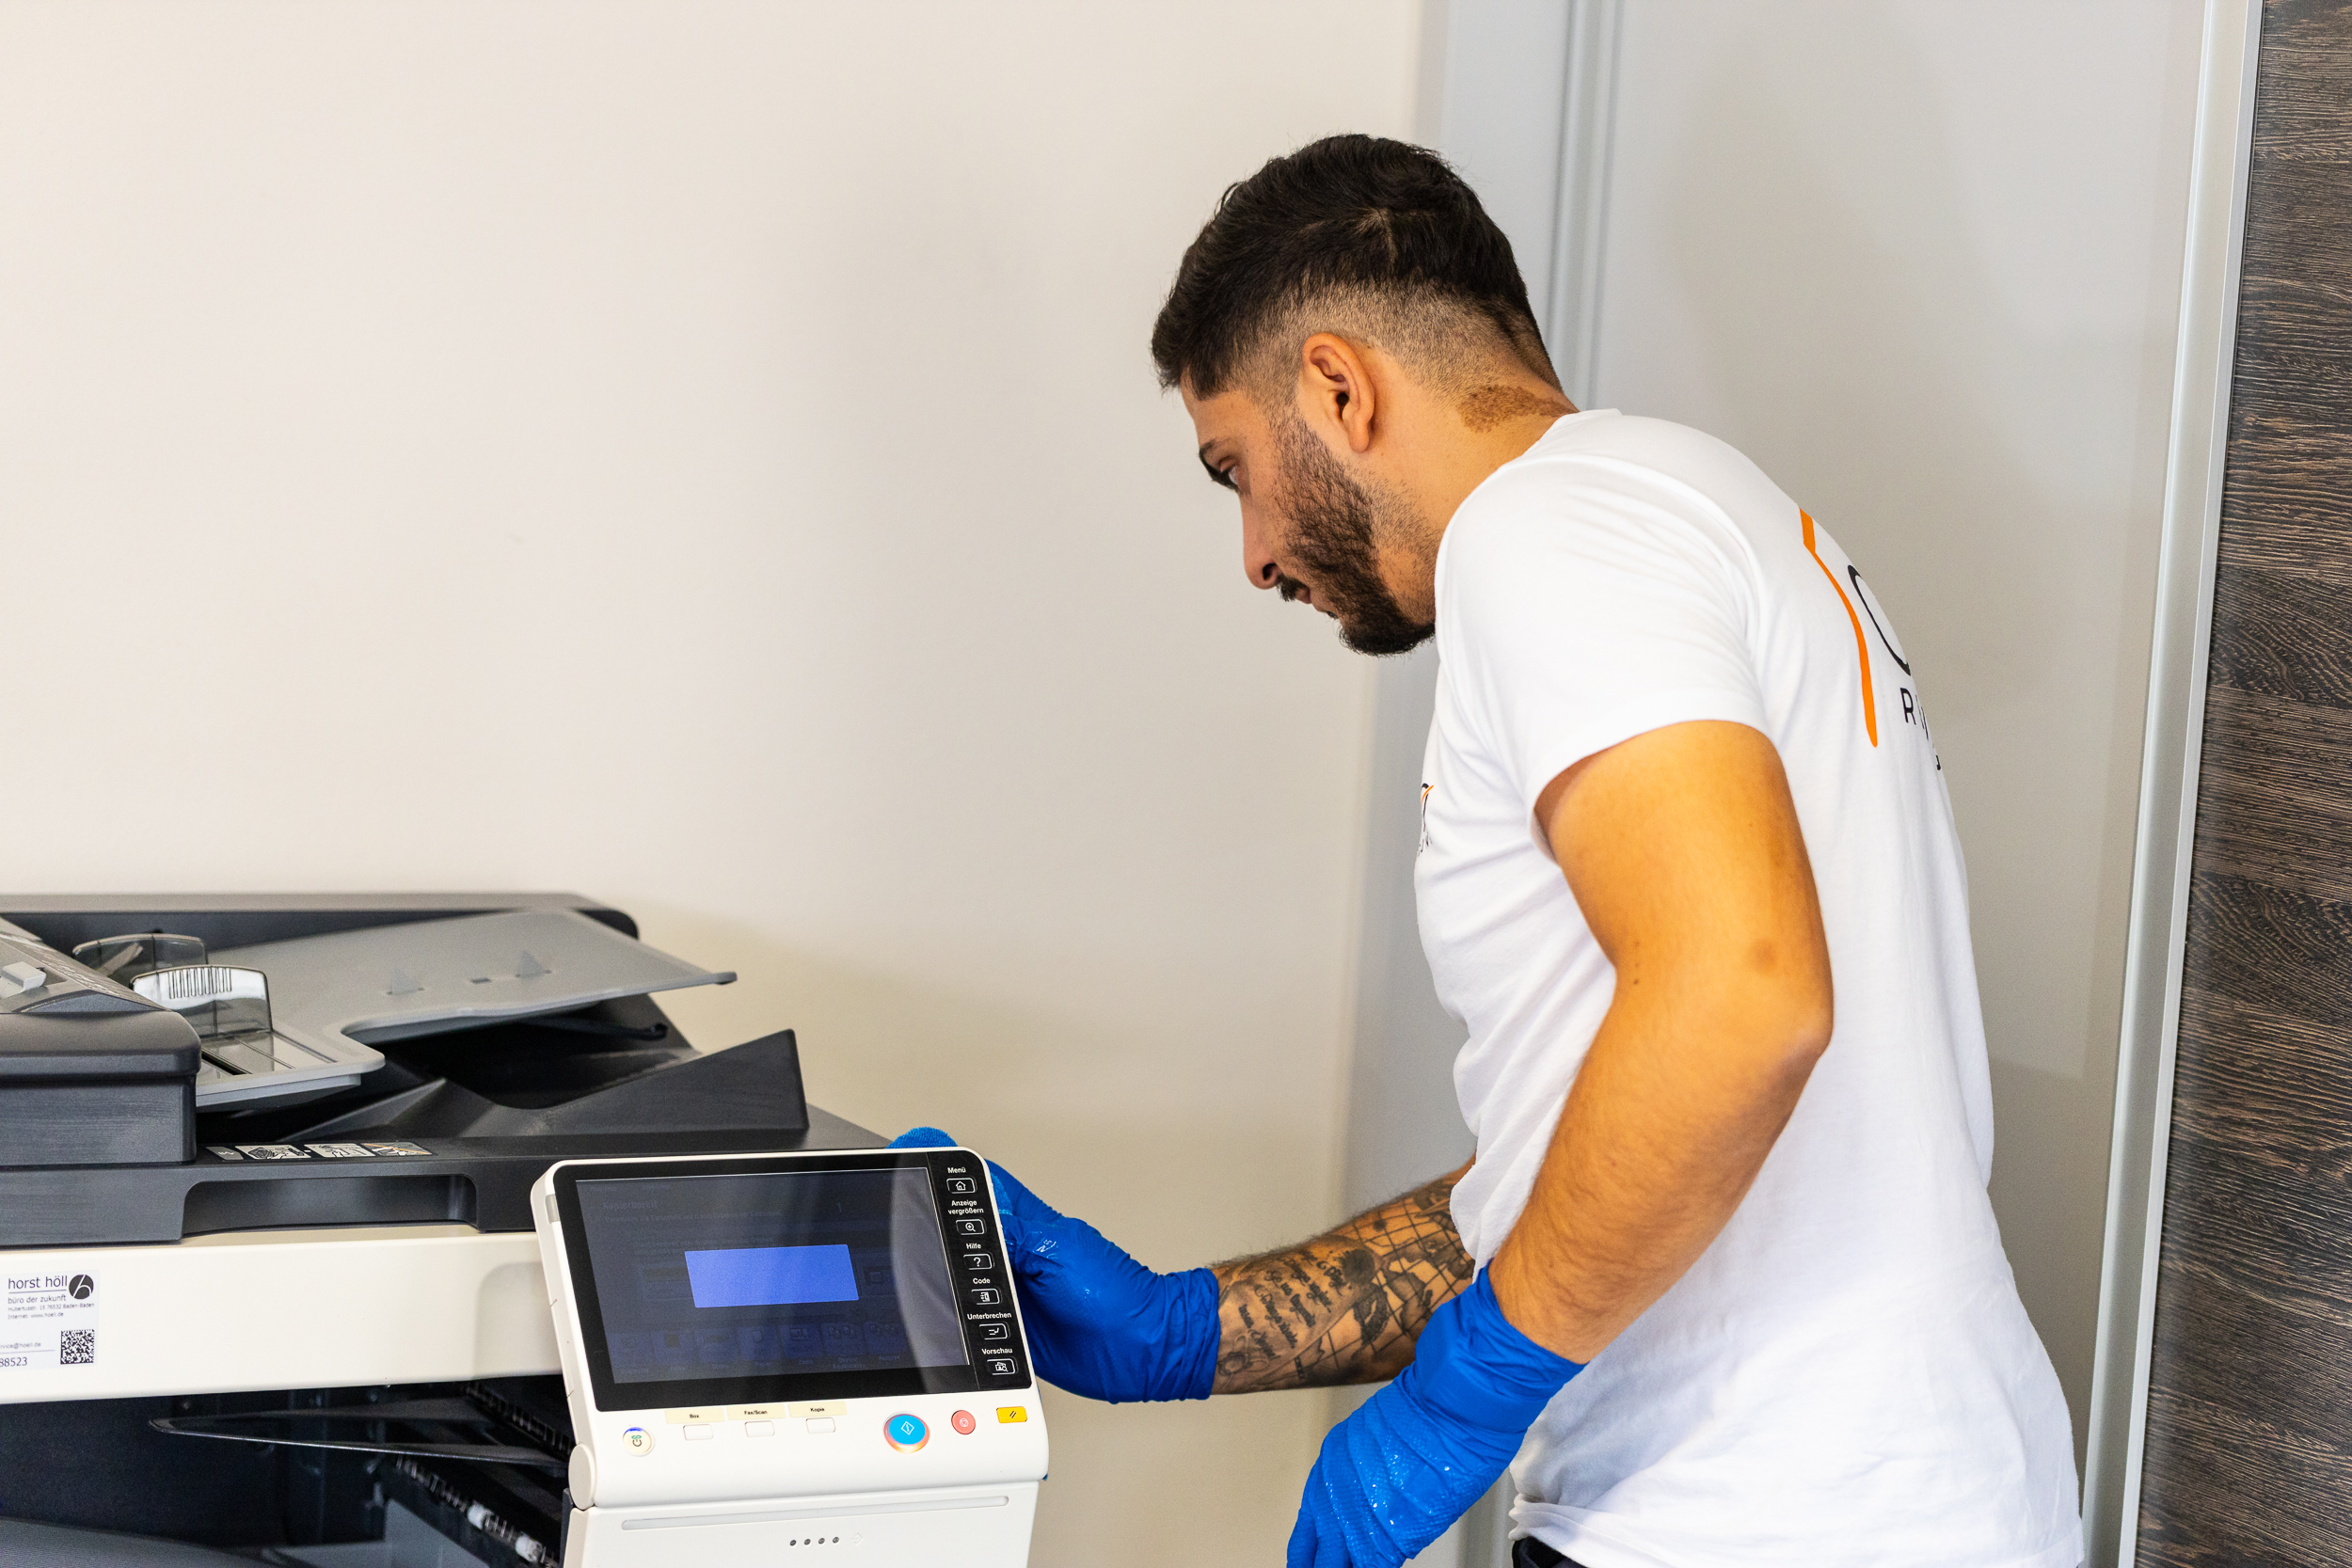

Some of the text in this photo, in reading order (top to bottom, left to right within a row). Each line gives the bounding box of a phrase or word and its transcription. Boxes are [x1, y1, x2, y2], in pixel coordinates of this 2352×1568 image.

[8, 1275, 68, 1290] horst höll
[40, 1293, 67, 1303] zukunft
